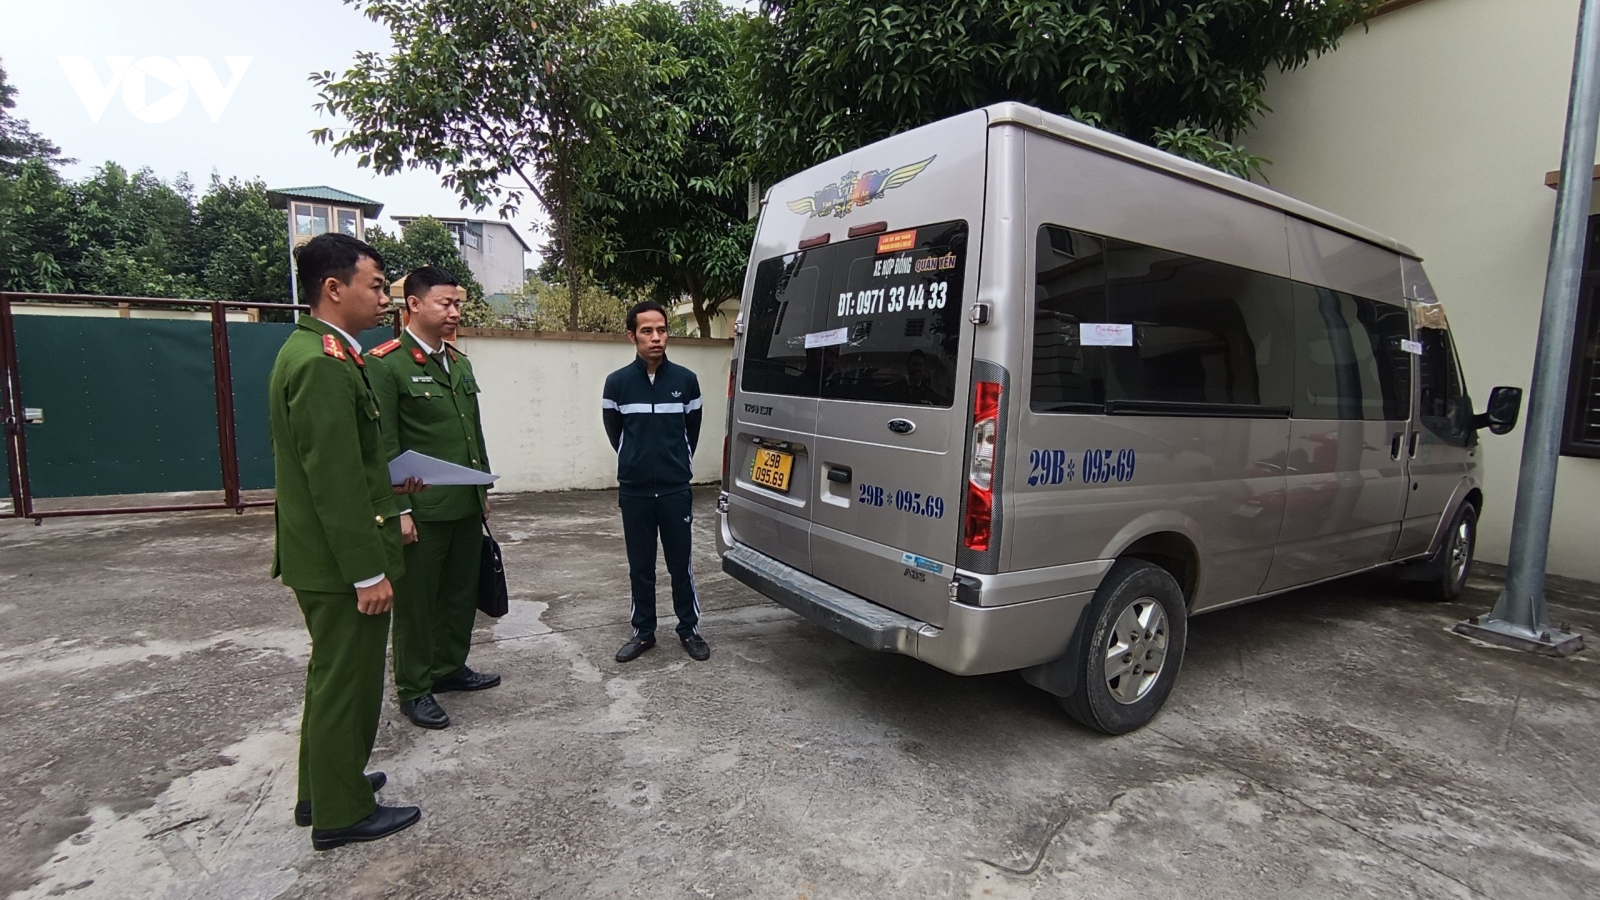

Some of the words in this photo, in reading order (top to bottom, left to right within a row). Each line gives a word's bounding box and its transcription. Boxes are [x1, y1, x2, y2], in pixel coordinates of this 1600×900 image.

[873, 260, 882, 277] XE
[856, 288, 885, 315] 0971
[887, 286, 905, 312] 33
[907, 283, 925, 310] 44
[927, 281, 948, 310] 33
[764, 452, 781, 469] 29B
[755, 466, 784, 487] 095.69
